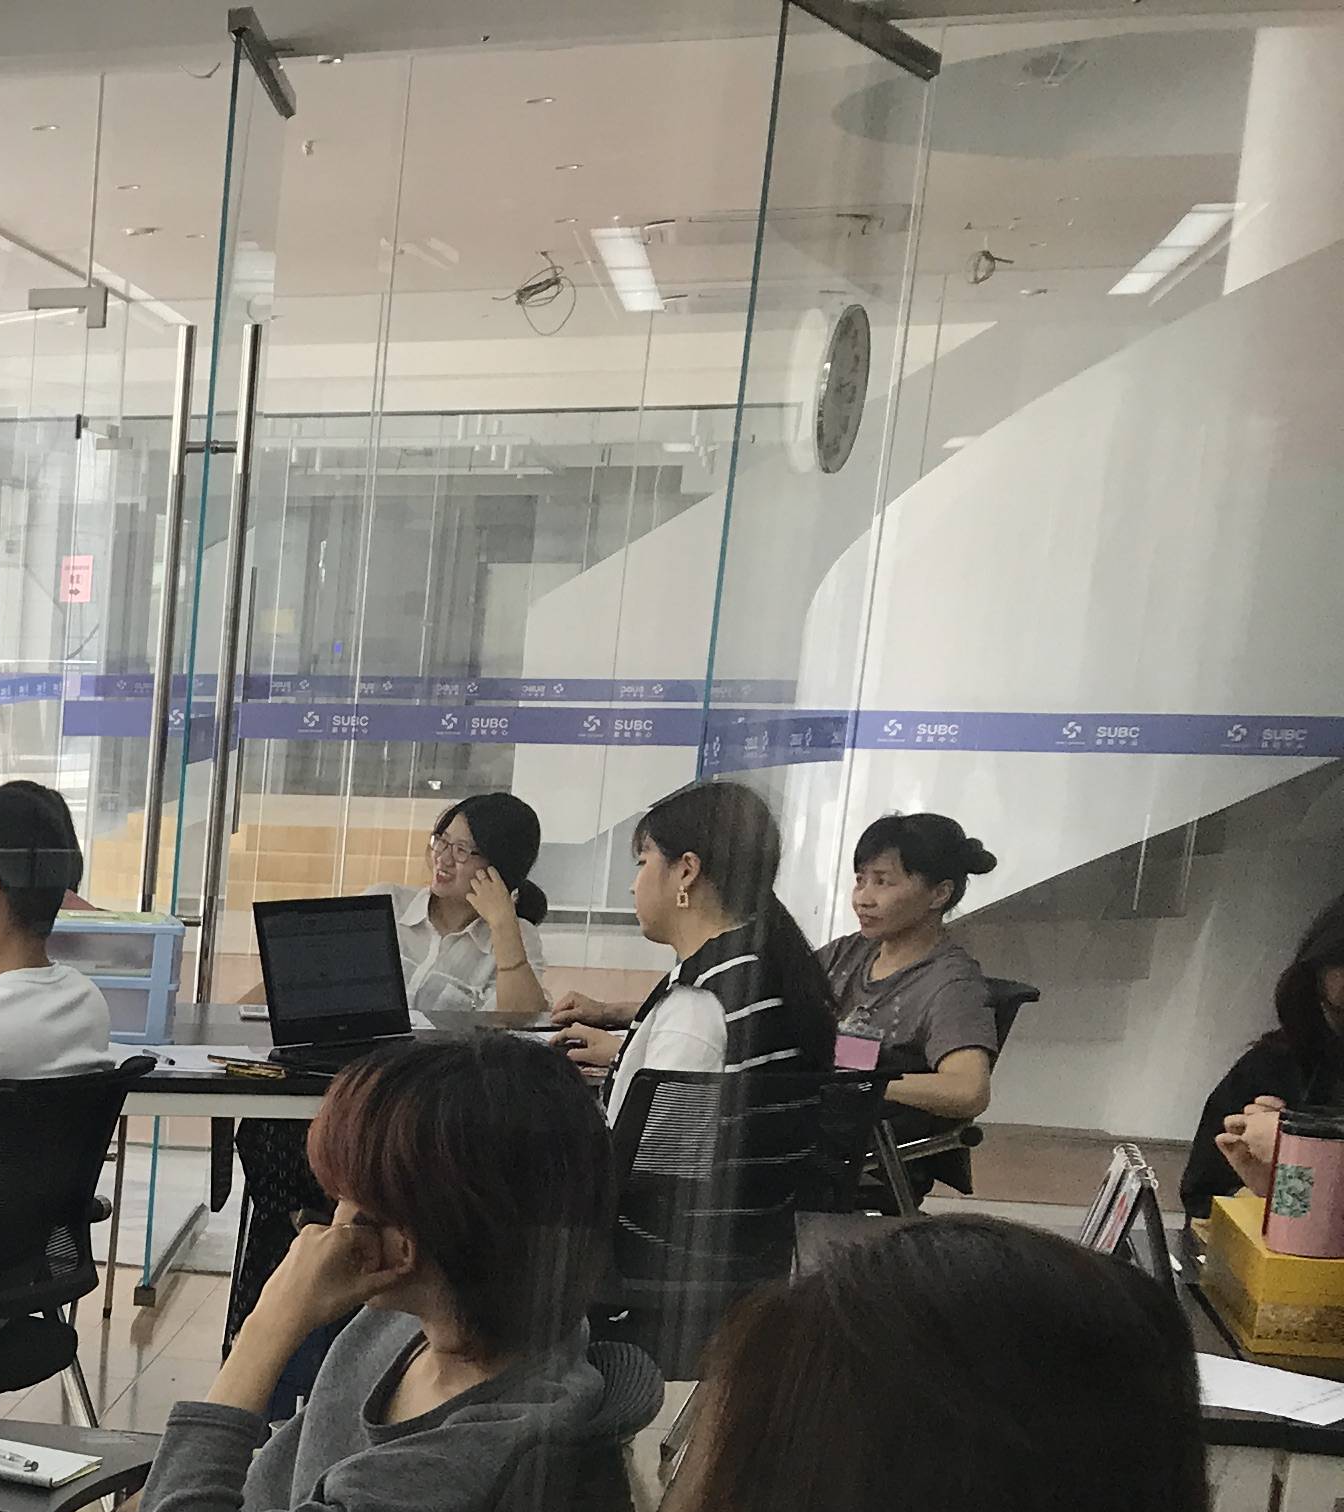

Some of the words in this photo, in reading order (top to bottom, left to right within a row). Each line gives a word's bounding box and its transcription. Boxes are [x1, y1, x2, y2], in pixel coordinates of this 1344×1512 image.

[332, 715, 369, 727] SUBC
[471, 718, 509, 729] SUBC
[614, 719, 653, 731] SUBC
[917, 723, 960, 735] SUBC
[1095, 726, 1140, 738] SUBC
[1262, 728, 1308, 741] SUBC
